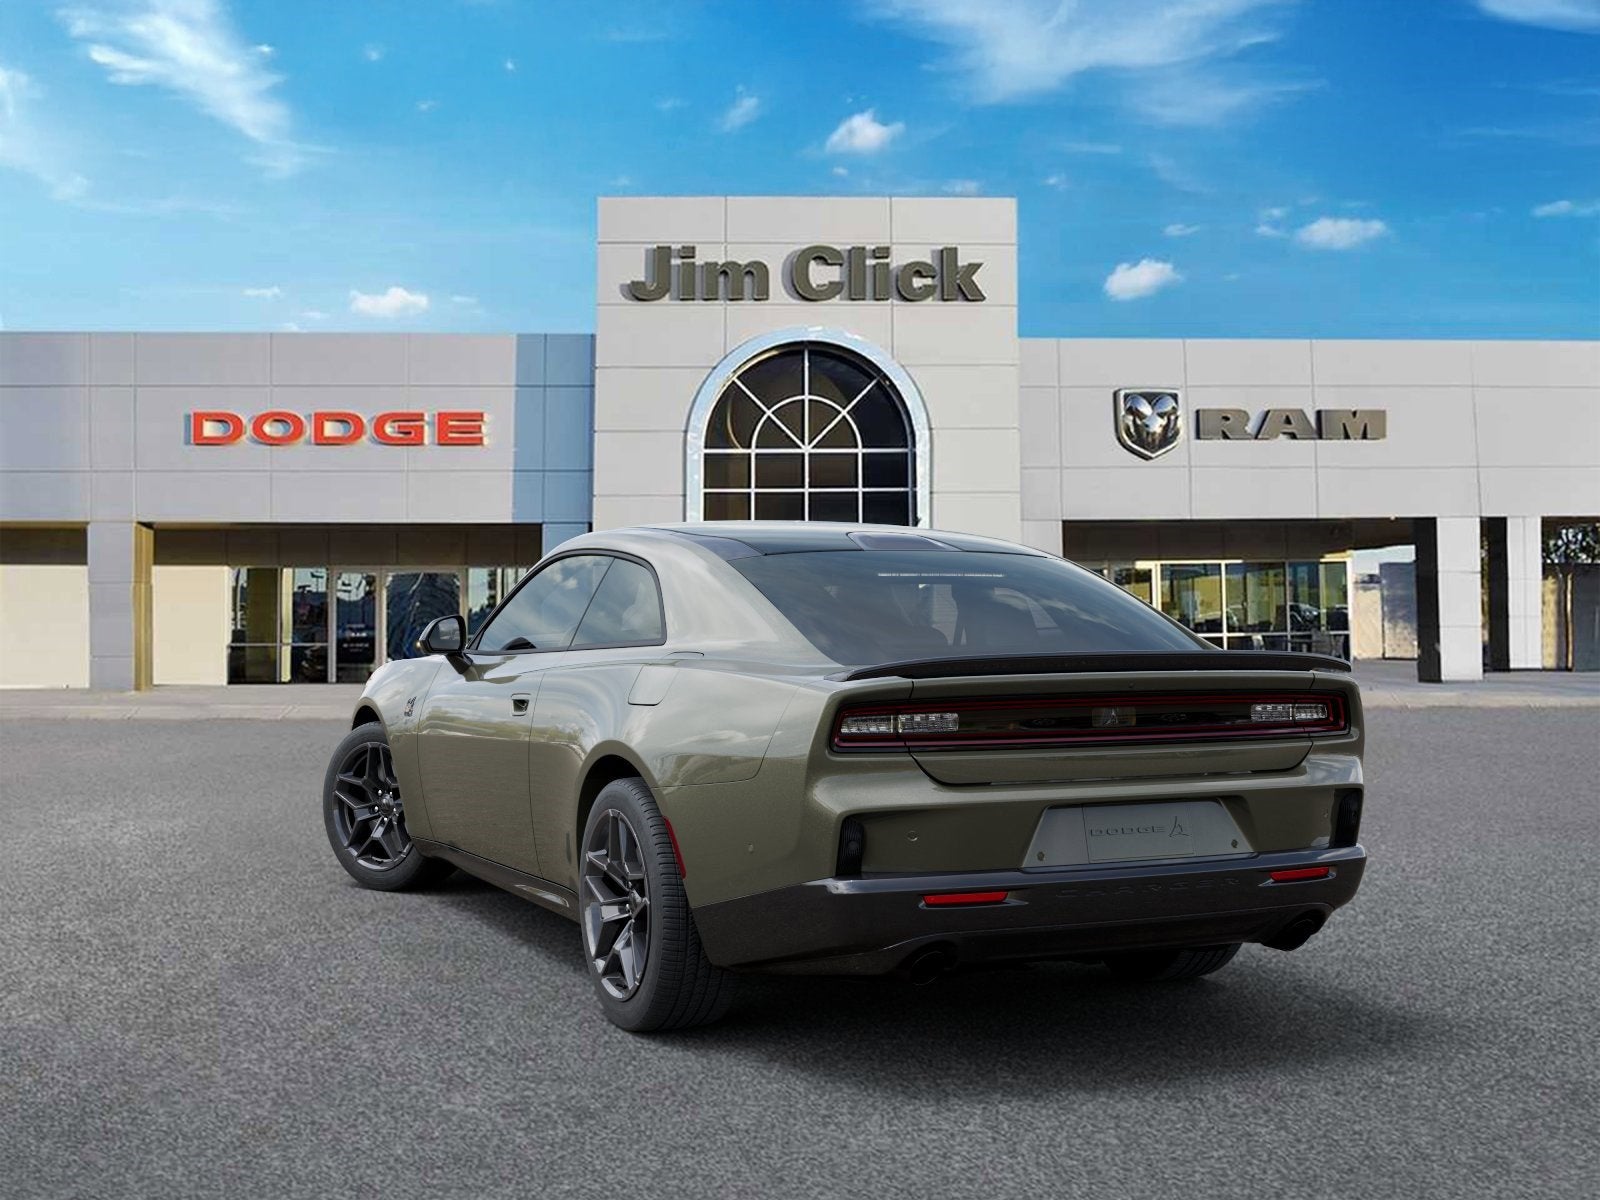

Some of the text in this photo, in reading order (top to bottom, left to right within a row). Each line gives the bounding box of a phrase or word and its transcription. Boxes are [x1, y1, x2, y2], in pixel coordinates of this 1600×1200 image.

[627, 245, 986, 301] Jim Click
[188, 411, 485, 446] DODGE
[1195, 408, 1387, 440] RAM
[1089, 825, 1166, 837] DODGE
